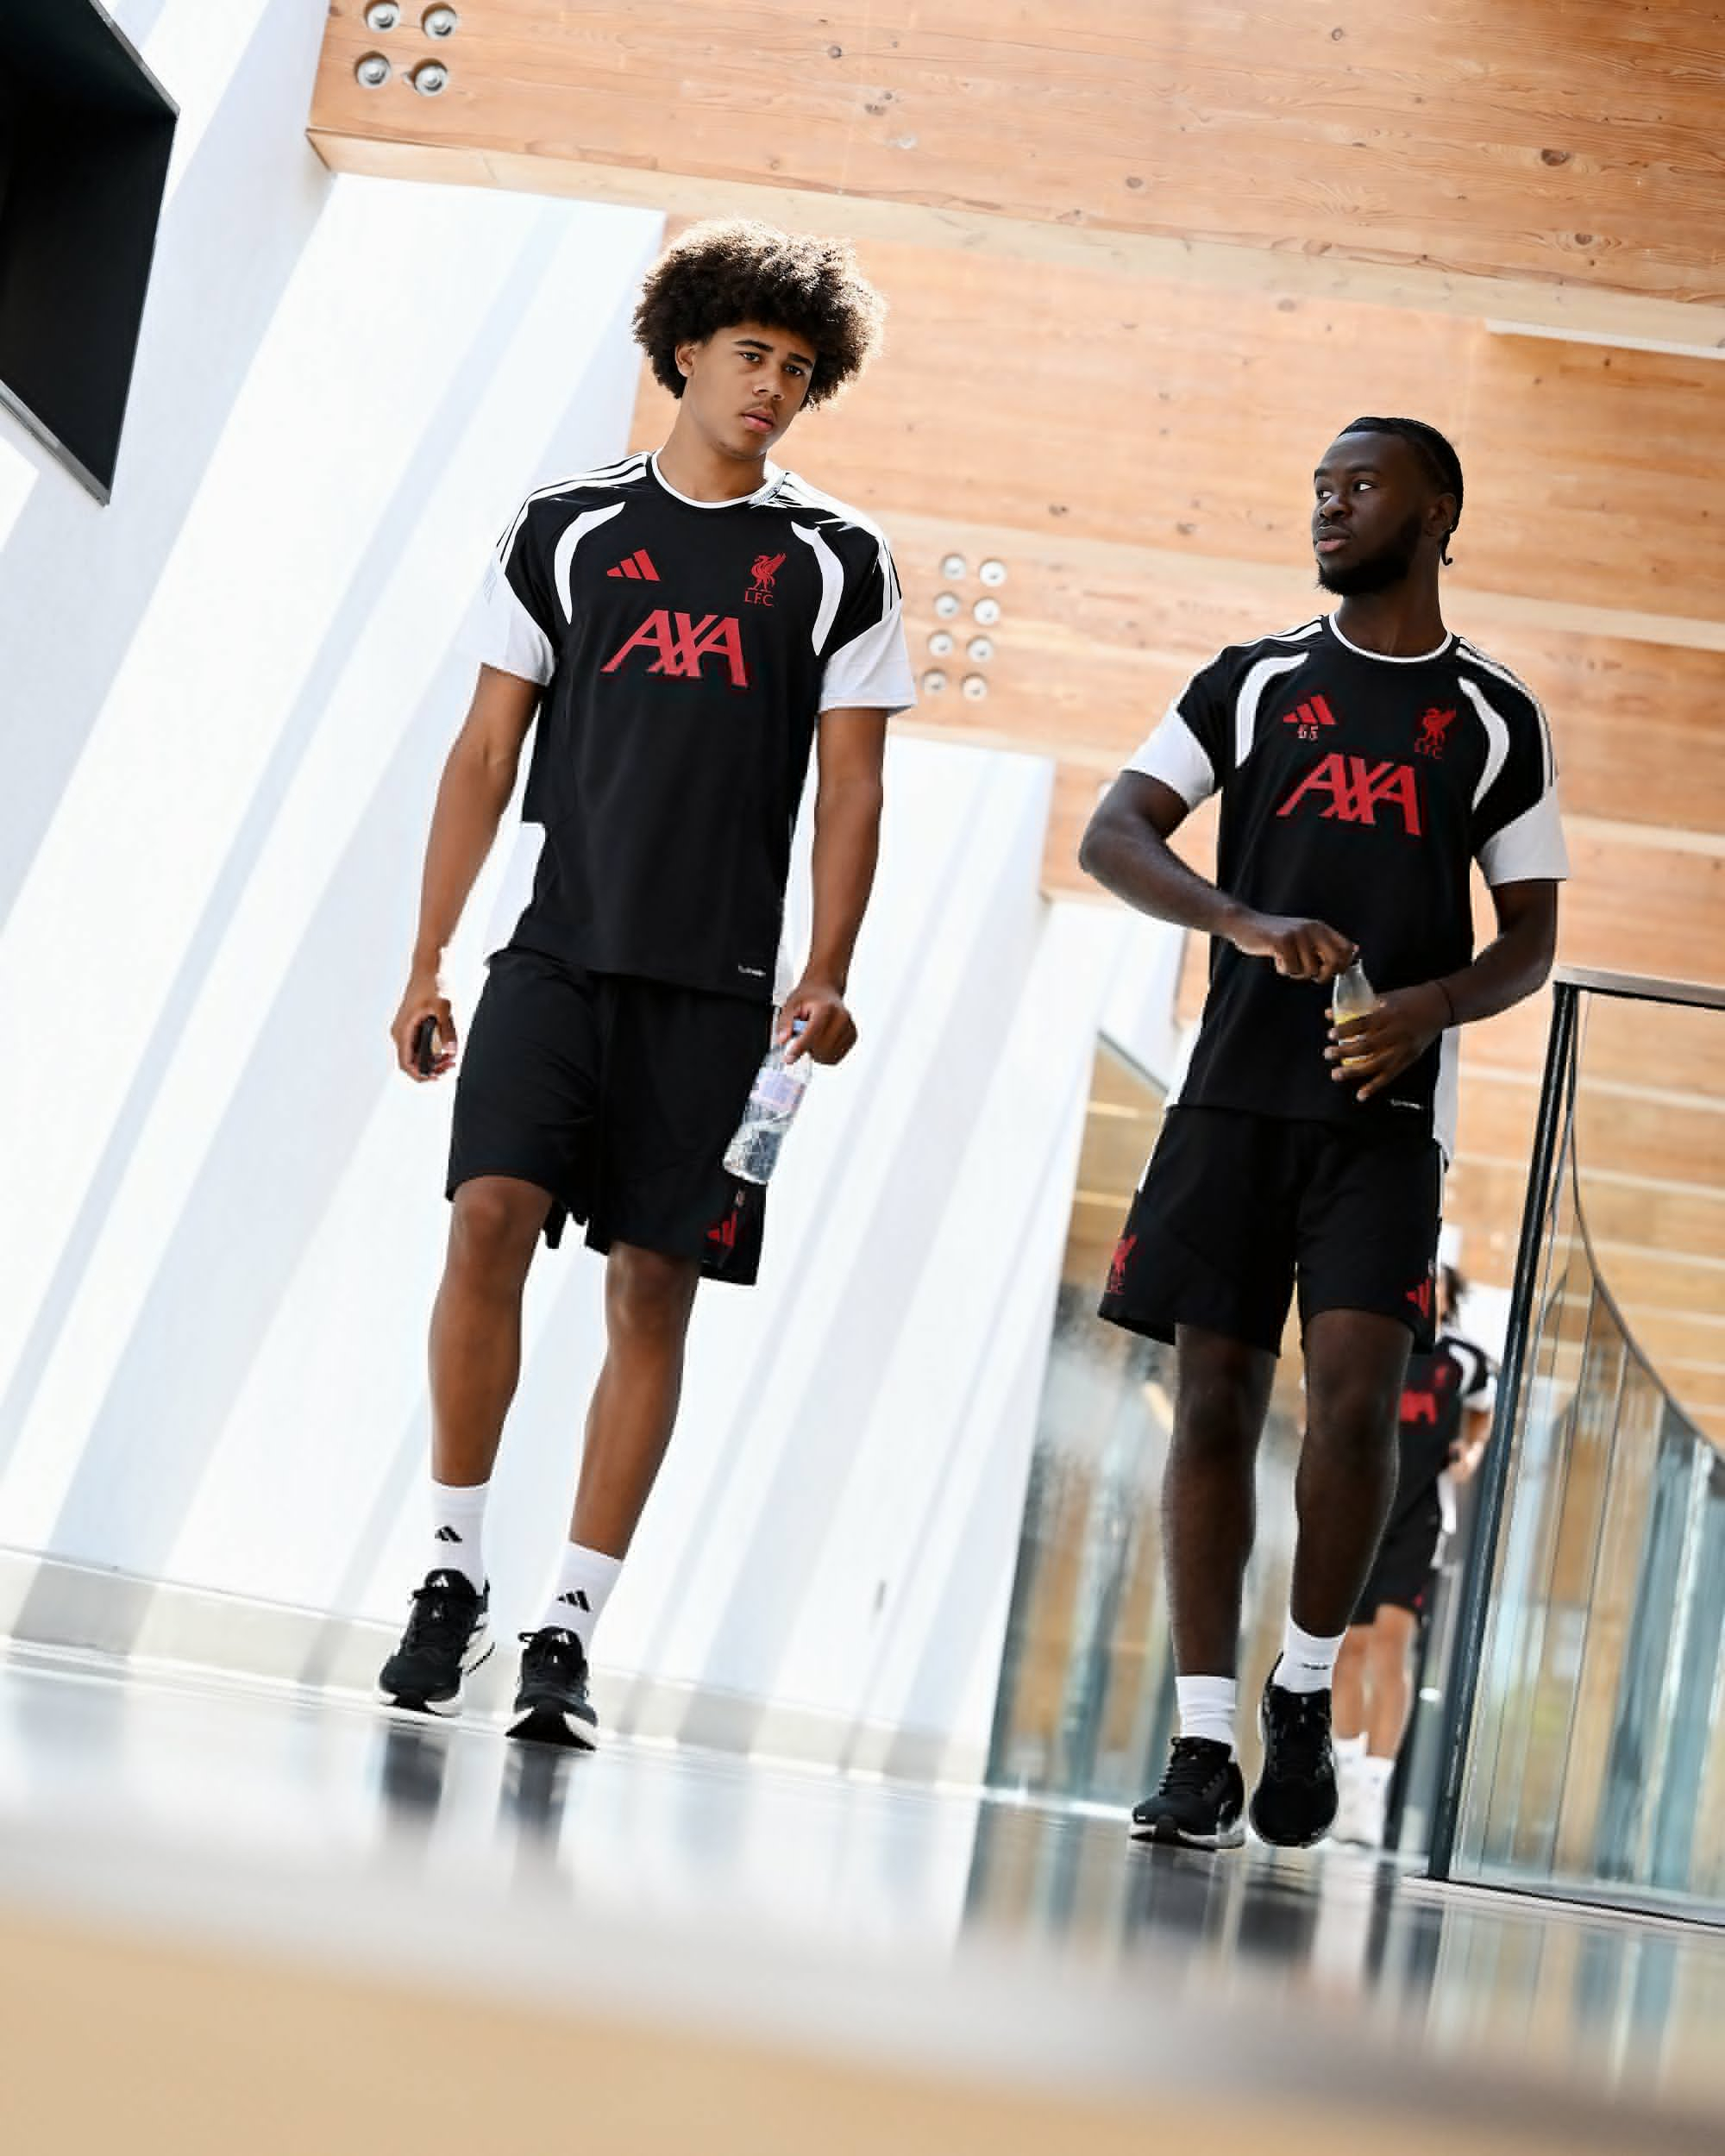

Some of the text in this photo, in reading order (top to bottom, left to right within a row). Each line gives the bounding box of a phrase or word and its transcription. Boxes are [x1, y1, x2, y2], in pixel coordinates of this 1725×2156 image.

[743, 590, 775, 607] LFC
[601, 609, 749, 687] AXA
[1276, 752, 1421, 836] AXA
